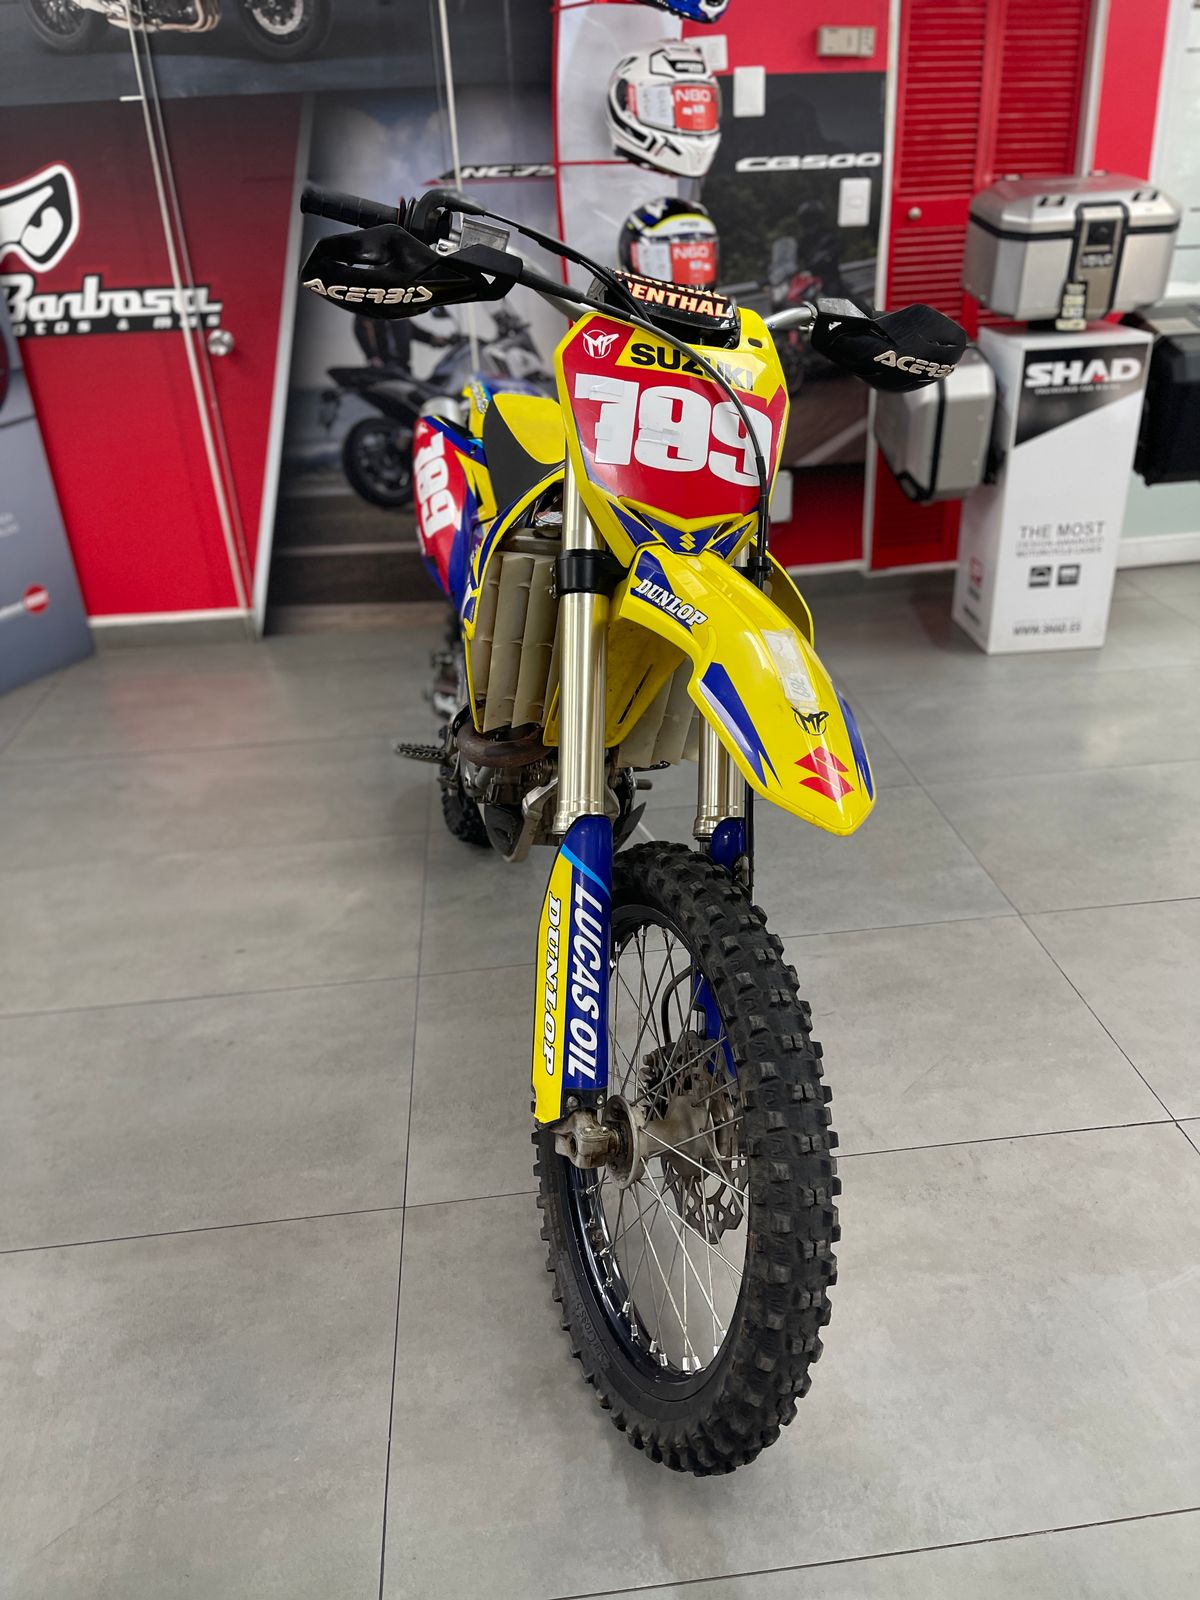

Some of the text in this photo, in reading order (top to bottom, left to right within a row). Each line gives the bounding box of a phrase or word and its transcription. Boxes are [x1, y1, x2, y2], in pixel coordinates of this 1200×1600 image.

[735, 152, 882, 172] CB500
[0, 273, 223, 323] Barbosa
[303, 278, 433, 304] ACERBIS
[1024, 358, 1142, 388] SHAD
[1020, 520, 1105, 539] THE MOST
[634, 579, 708, 627] DUNLOP
[543, 891, 562, 1075] DUNLOP
[568, 883, 603, 1080] LUCAS OIL
